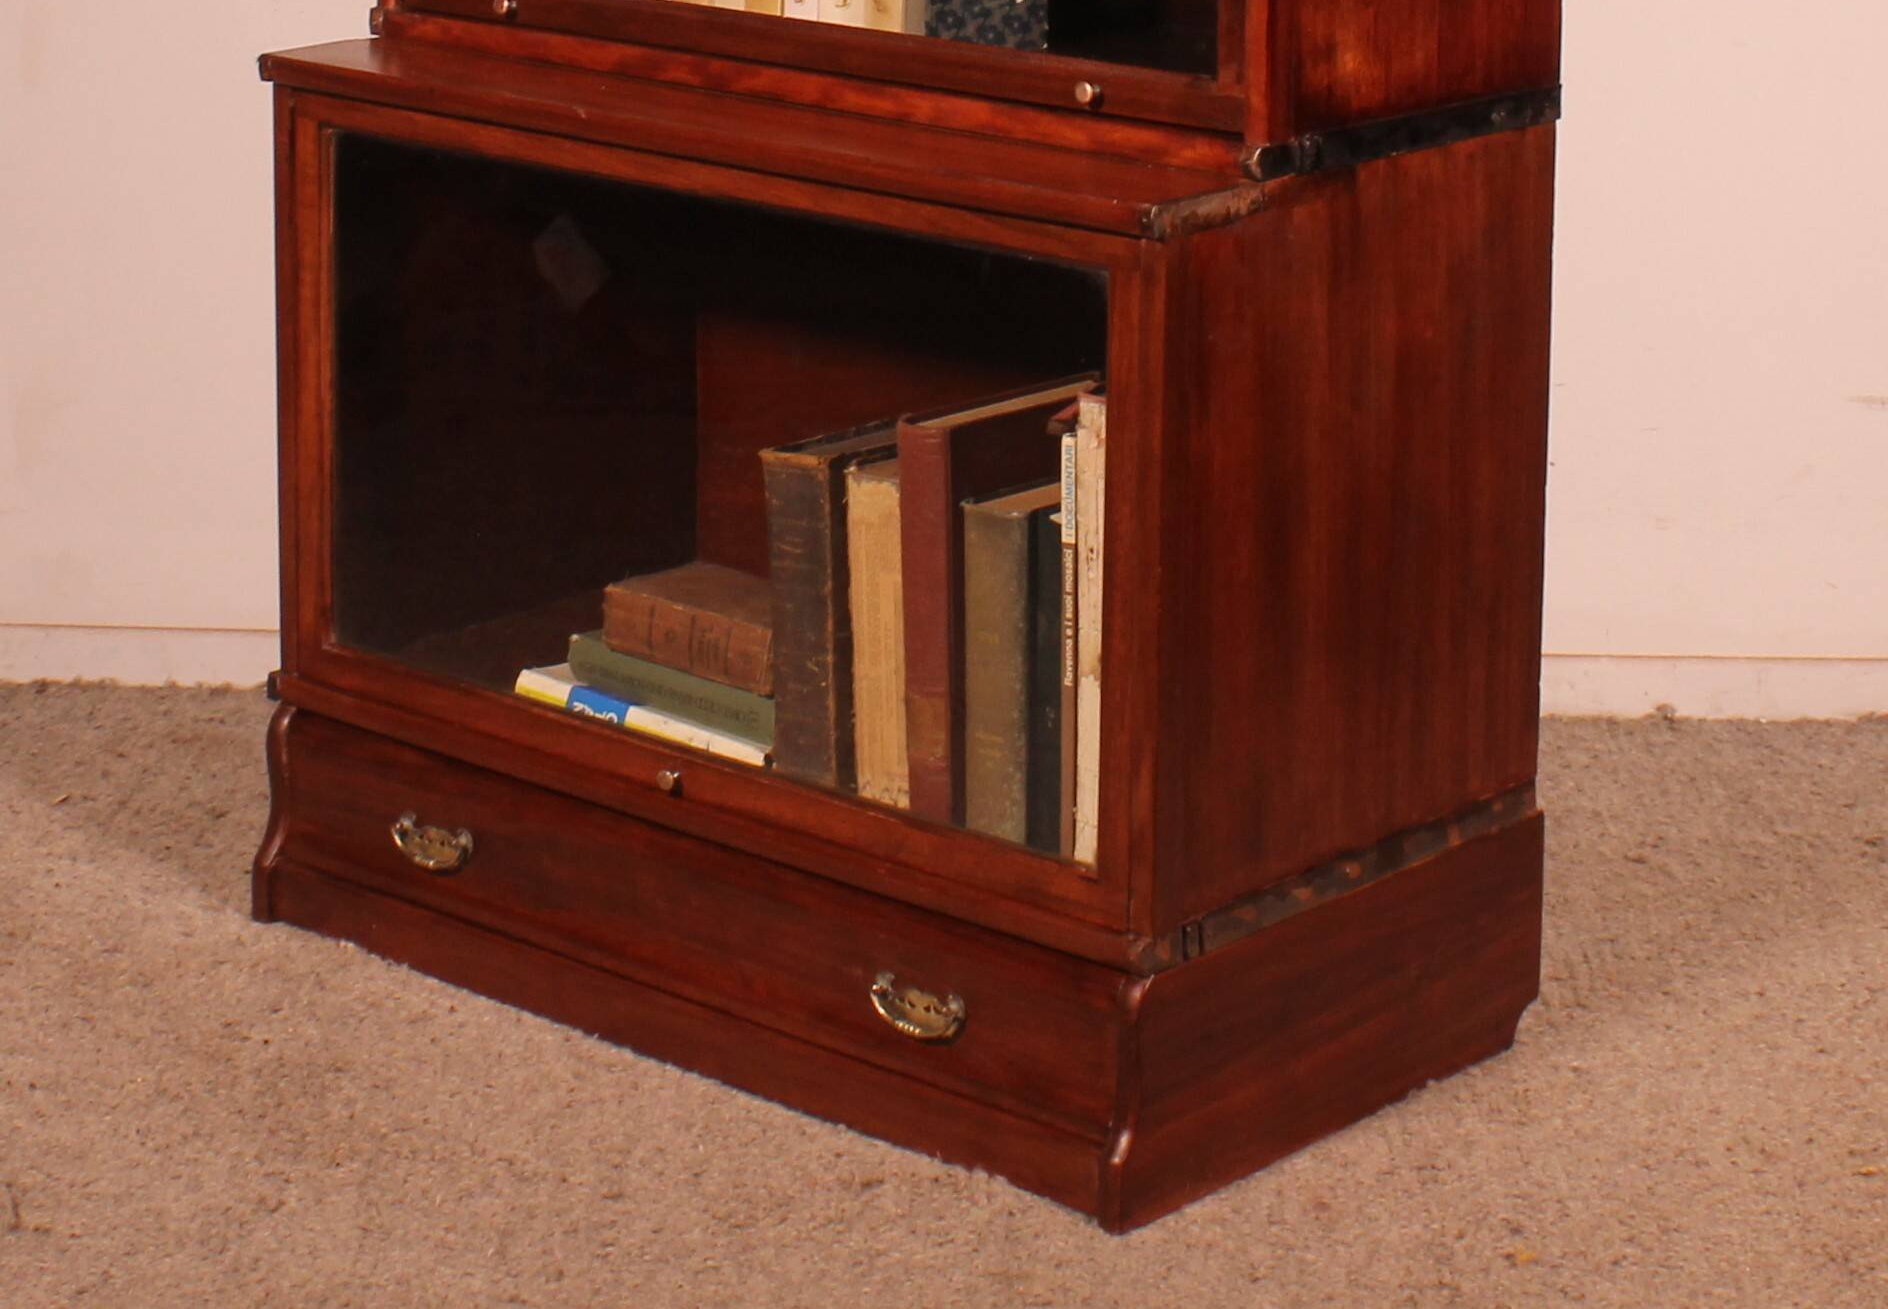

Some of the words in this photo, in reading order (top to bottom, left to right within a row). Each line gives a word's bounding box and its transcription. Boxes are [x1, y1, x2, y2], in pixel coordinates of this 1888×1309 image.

[1065, 444, 1074, 530] DOCUMENTARI
[1063, 549, 1073, 593] mosaici
[1064, 595, 1073, 619] suoi
[1064, 638, 1073, 687] Ravenna
